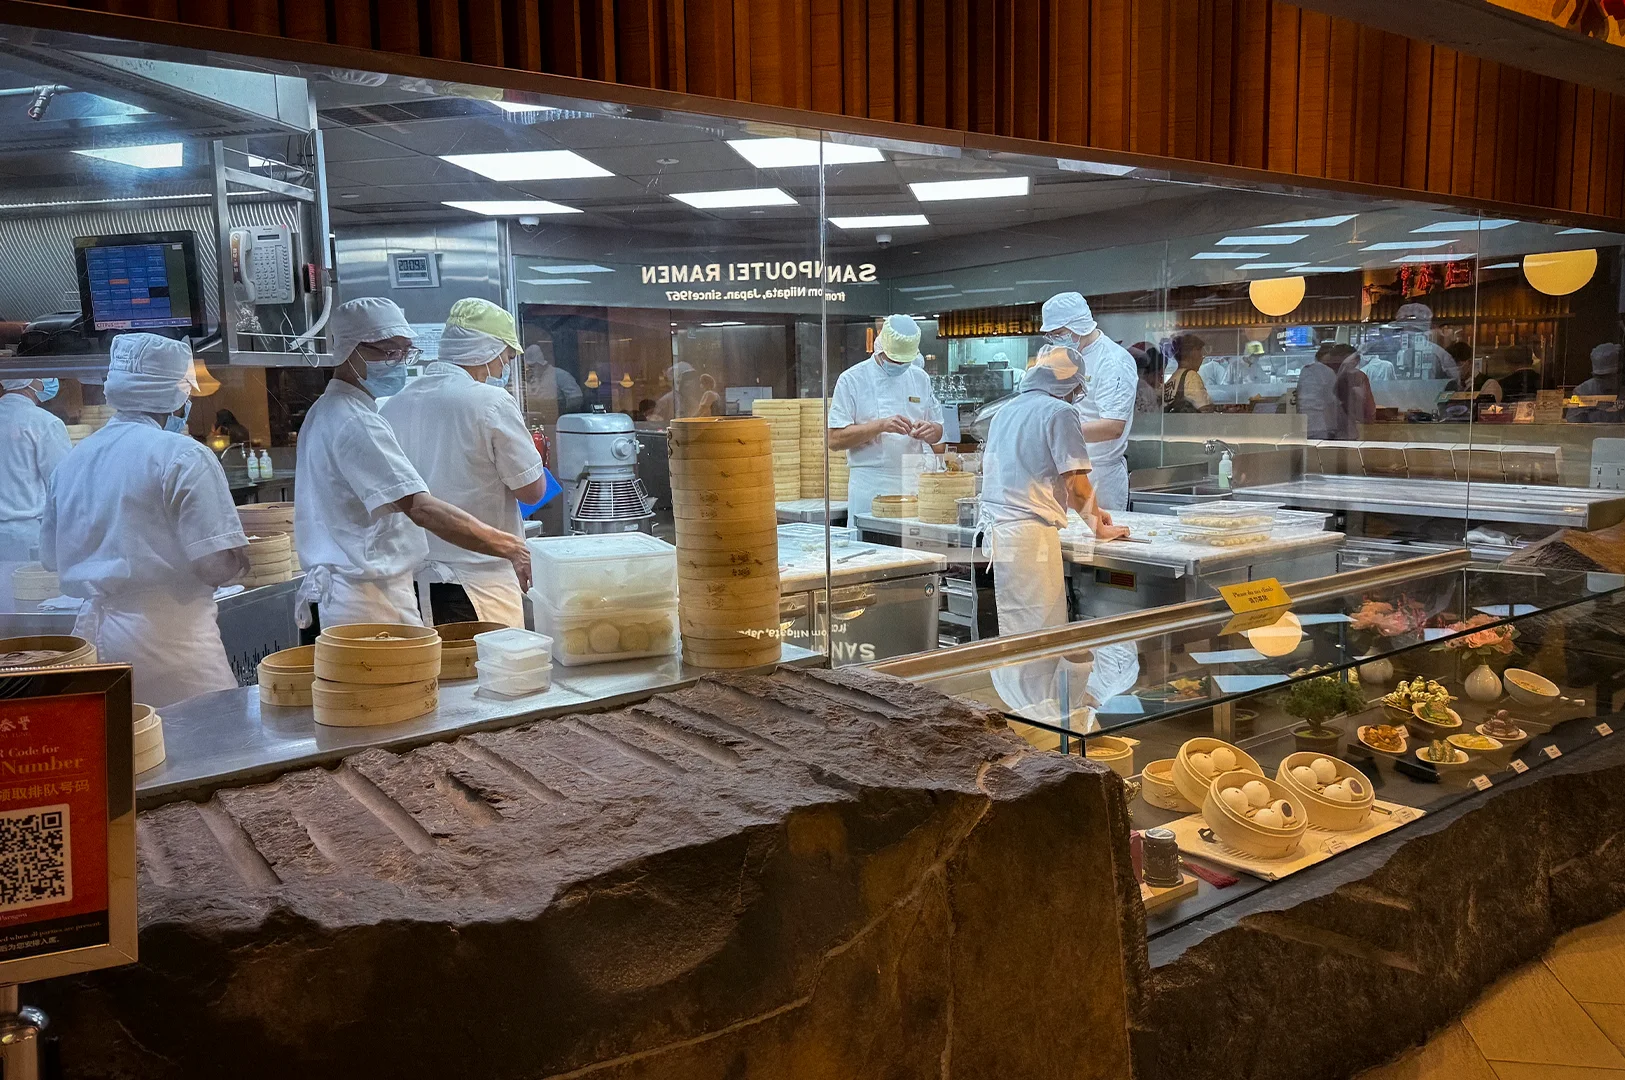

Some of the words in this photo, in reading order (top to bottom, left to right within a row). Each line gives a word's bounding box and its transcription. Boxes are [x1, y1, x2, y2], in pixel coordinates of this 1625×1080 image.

[9, 746, 39, 757] Code
[42, 744, 60, 754] for
[1, 755, 84, 776] Number
